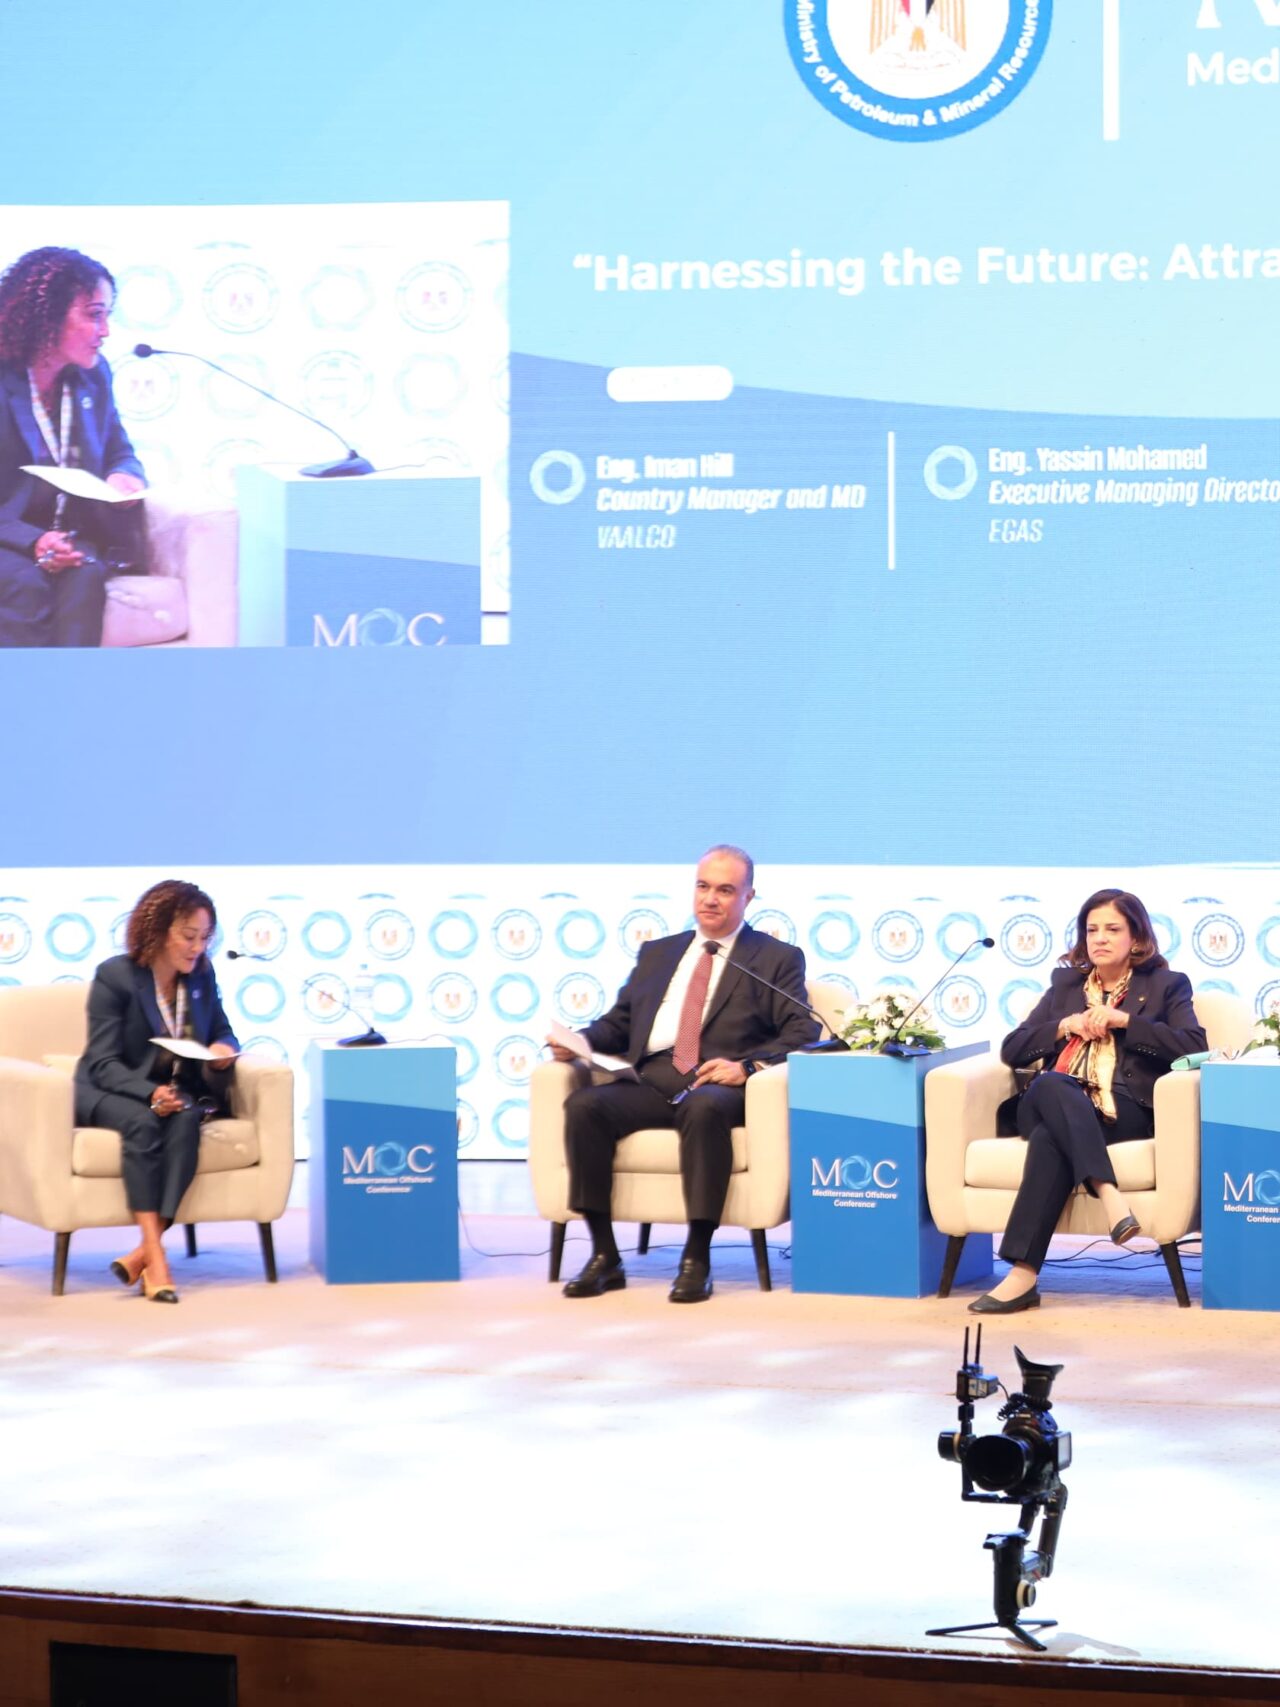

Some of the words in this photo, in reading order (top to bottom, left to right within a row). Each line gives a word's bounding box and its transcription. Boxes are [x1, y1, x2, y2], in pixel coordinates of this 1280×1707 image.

[815, 65, 838, 84] of
[922, 109, 938, 126] &
[939, 77, 1005, 122] Mineral
[881, 248, 962, 285] the
[977, 247, 1149, 284] Future:
[596, 455, 640, 483] Eng.
[988, 448, 1032, 476] Eng.
[1036, 446, 1103, 471] Yassin
[1107, 443, 1207, 471] Mohamed
[596, 487, 684, 515] Country
[687, 485, 782, 514] Manager
[785, 485, 828, 510] and
[988, 478, 1089, 505] Executive
[1094, 478, 1199, 507] Managing
[598, 524, 676, 549] VAALCO
[988, 519, 1044, 544] EGAS
[313, 607, 447, 647] MOC
[342, 1142, 434, 1175] MOC
[811, 1155, 898, 1189] MOC
[1223, 1204, 1278, 1213] Mediterranean
